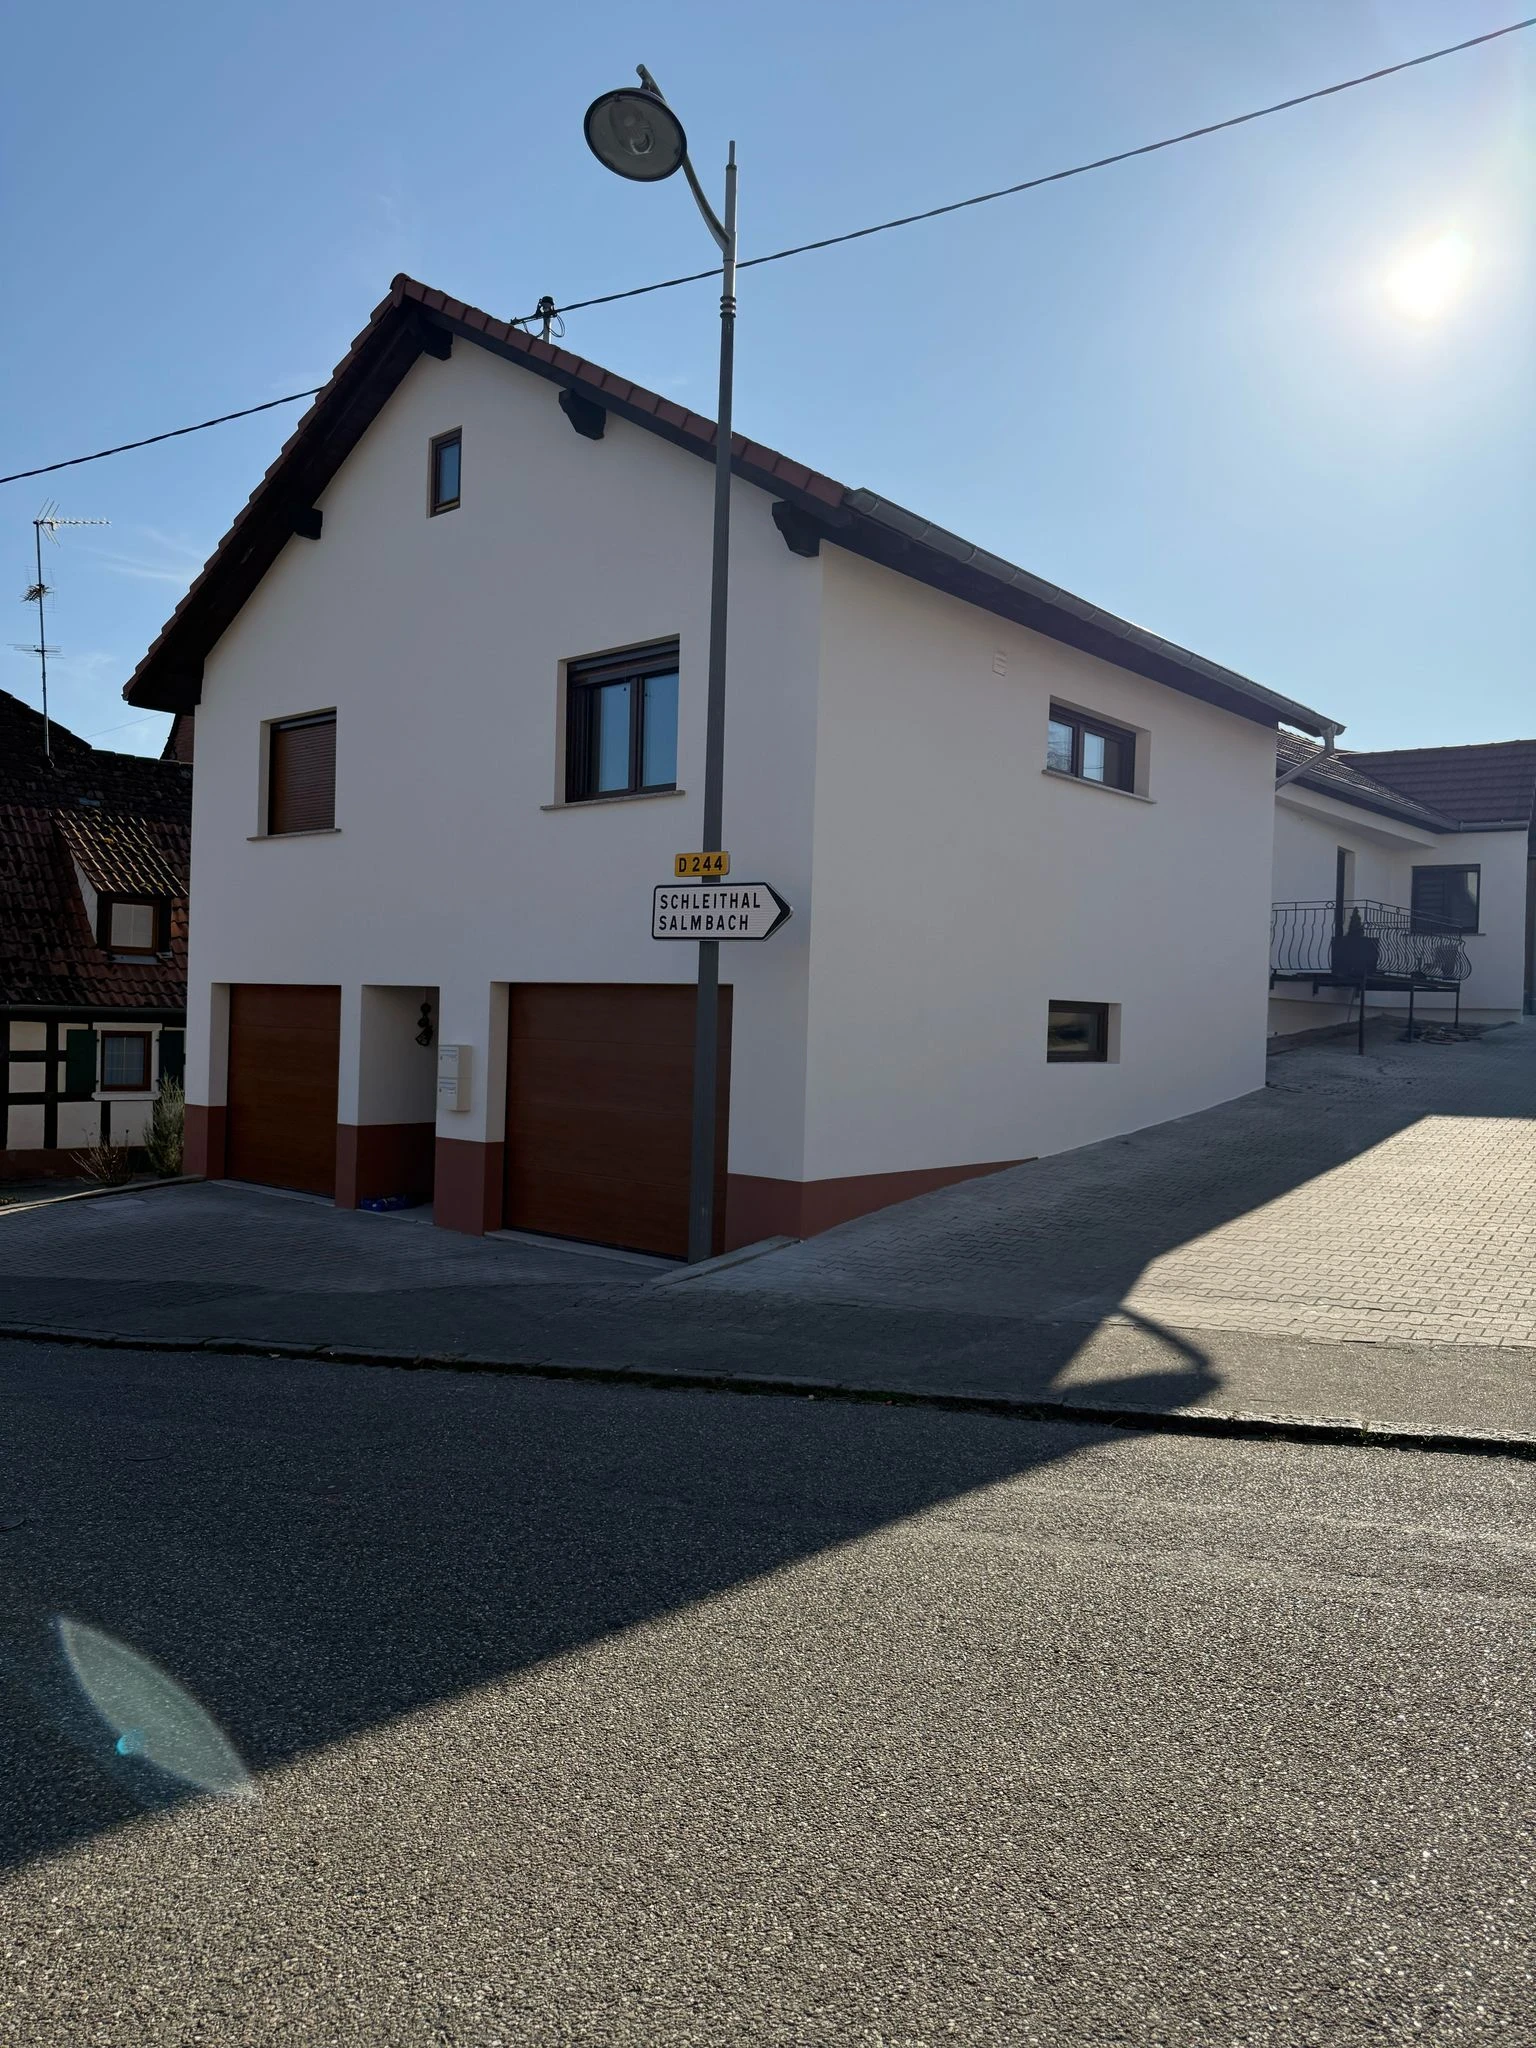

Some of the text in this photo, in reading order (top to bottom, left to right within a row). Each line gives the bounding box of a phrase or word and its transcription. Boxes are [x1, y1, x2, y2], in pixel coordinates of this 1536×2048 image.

[679, 856, 723, 872] D 244
[660, 892, 761, 909] SCHLEITHAL
[659, 914, 748, 930] SALMBACH
